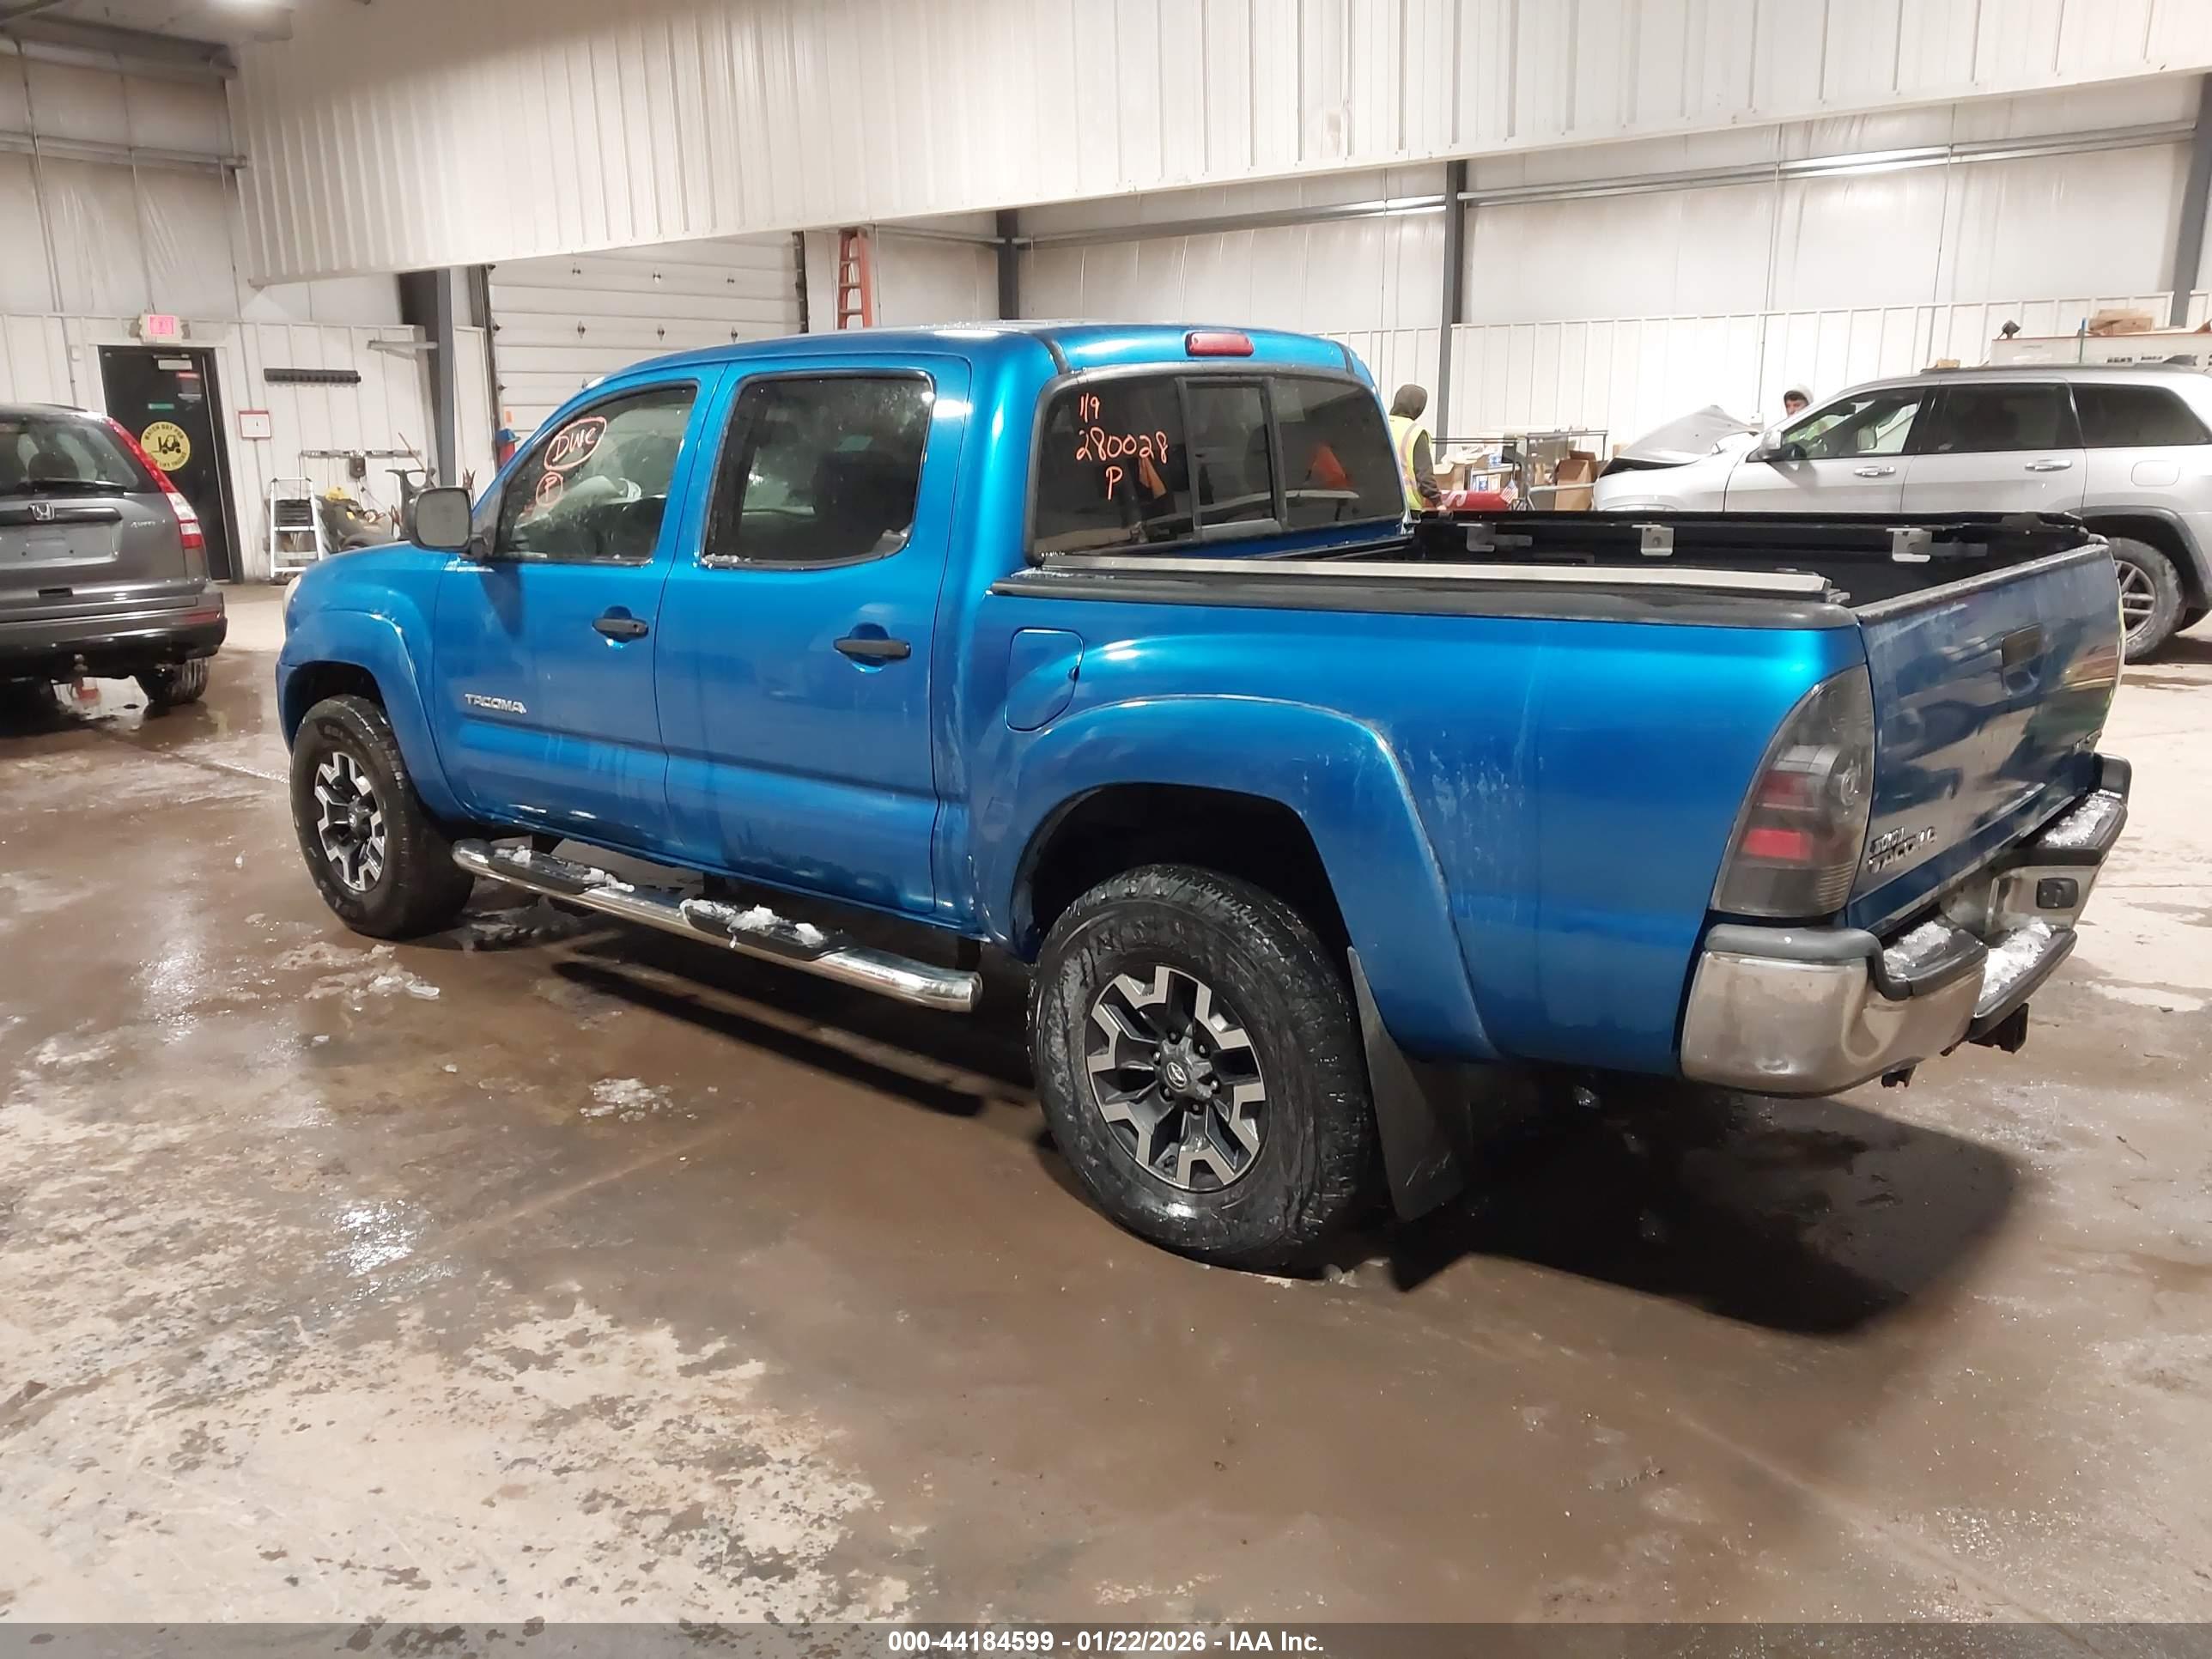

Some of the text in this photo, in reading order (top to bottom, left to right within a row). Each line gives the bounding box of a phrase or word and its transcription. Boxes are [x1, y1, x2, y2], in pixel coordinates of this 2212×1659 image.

[1076, 426, 1168, 465] 280028
[544, 476, 558, 502] P
[1105, 465, 1123, 501] P
[465, 693, 527, 714] TACOMA
